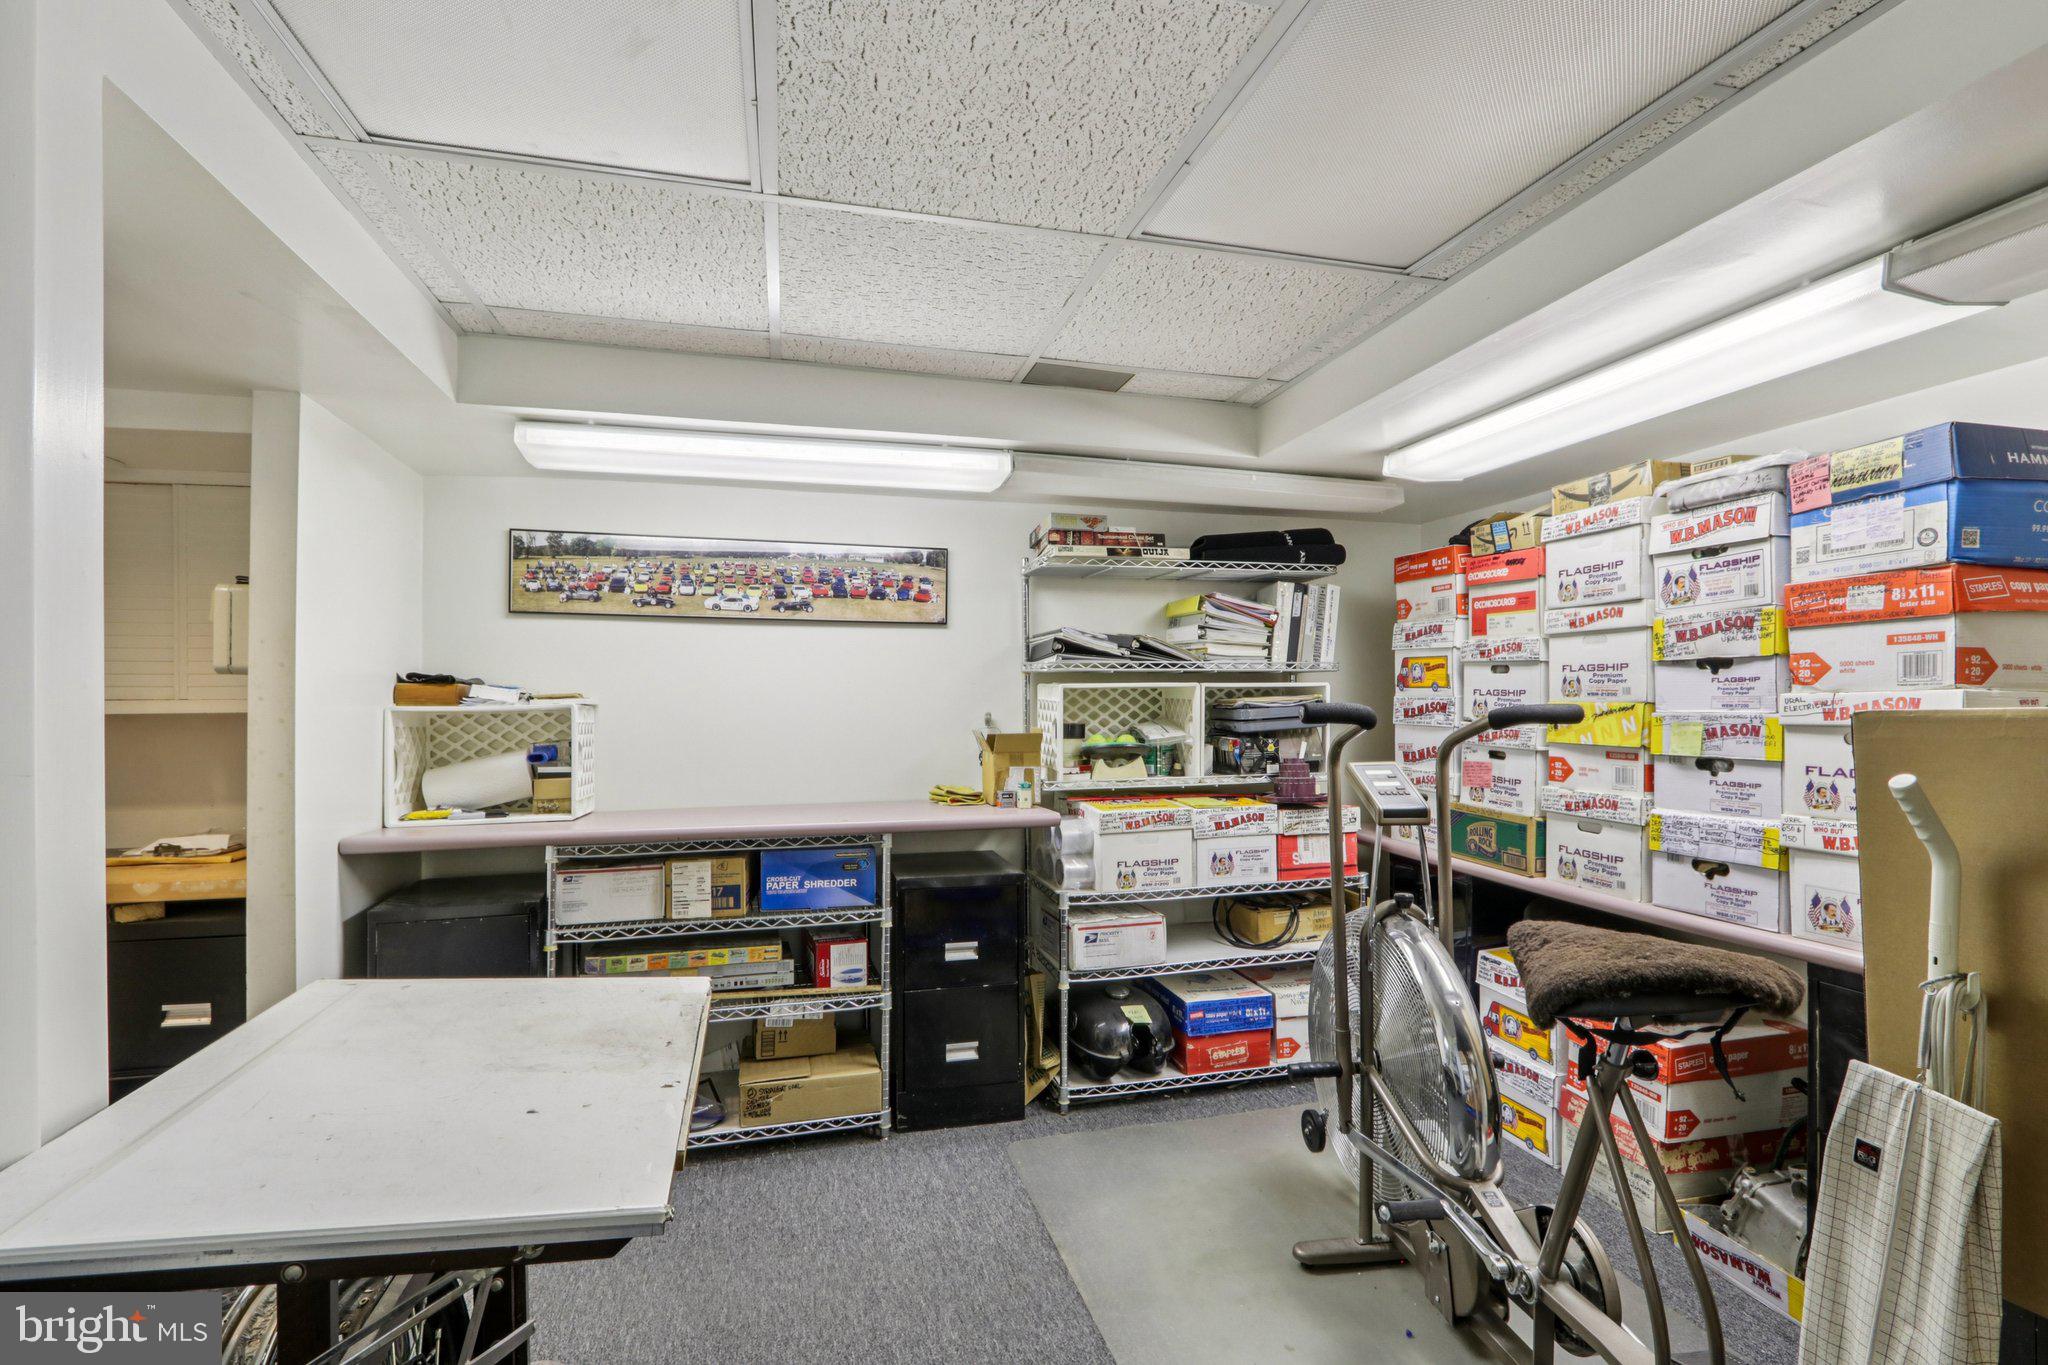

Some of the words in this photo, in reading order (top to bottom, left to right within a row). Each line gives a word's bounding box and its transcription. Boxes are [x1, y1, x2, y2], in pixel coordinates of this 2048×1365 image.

[1700, 555, 1760, 571] FLAGSHIP
[1559, 560, 1623, 578] FLAGSHIP
[1603, 576, 1622, 584] Paper
[1908, 589, 1918, 599] x
[1920, 584, 1935, 597] 11
[1969, 582, 2003, 593] STAPLES
[2010, 582, 2032, 592] copy
[1799, 659, 1810, 667] 92
[1970, 655, 1980, 664] 92
[1562, 663, 1629, 672] FLAGSHIP
[1799, 669, 1810, 677] 20
[1970, 667, 1980, 675] 20
[1473, 689, 1526, 697] FLAGSHIP
[1709, 780, 1761, 789] FLAGSHIP
[1470, 826, 1493, 839] ROLLING
[1559, 845, 1624, 864] FLAGSHIP
[1117, 858, 1179, 868] FLAGSHIP
[1584, 865, 1599, 873] Copy
[1601, 868, 1622, 877] Paper
[766, 882, 799, 890] PAPER
[804, 879, 857, 889] SHREDDER
[1704, 883, 1758, 896] FLAGSHIP
[1728, 1051, 1749, 1062] paper
[1678, 1058, 1704, 1070] STAPLES
[1679, 1115, 1687, 1123] 92
